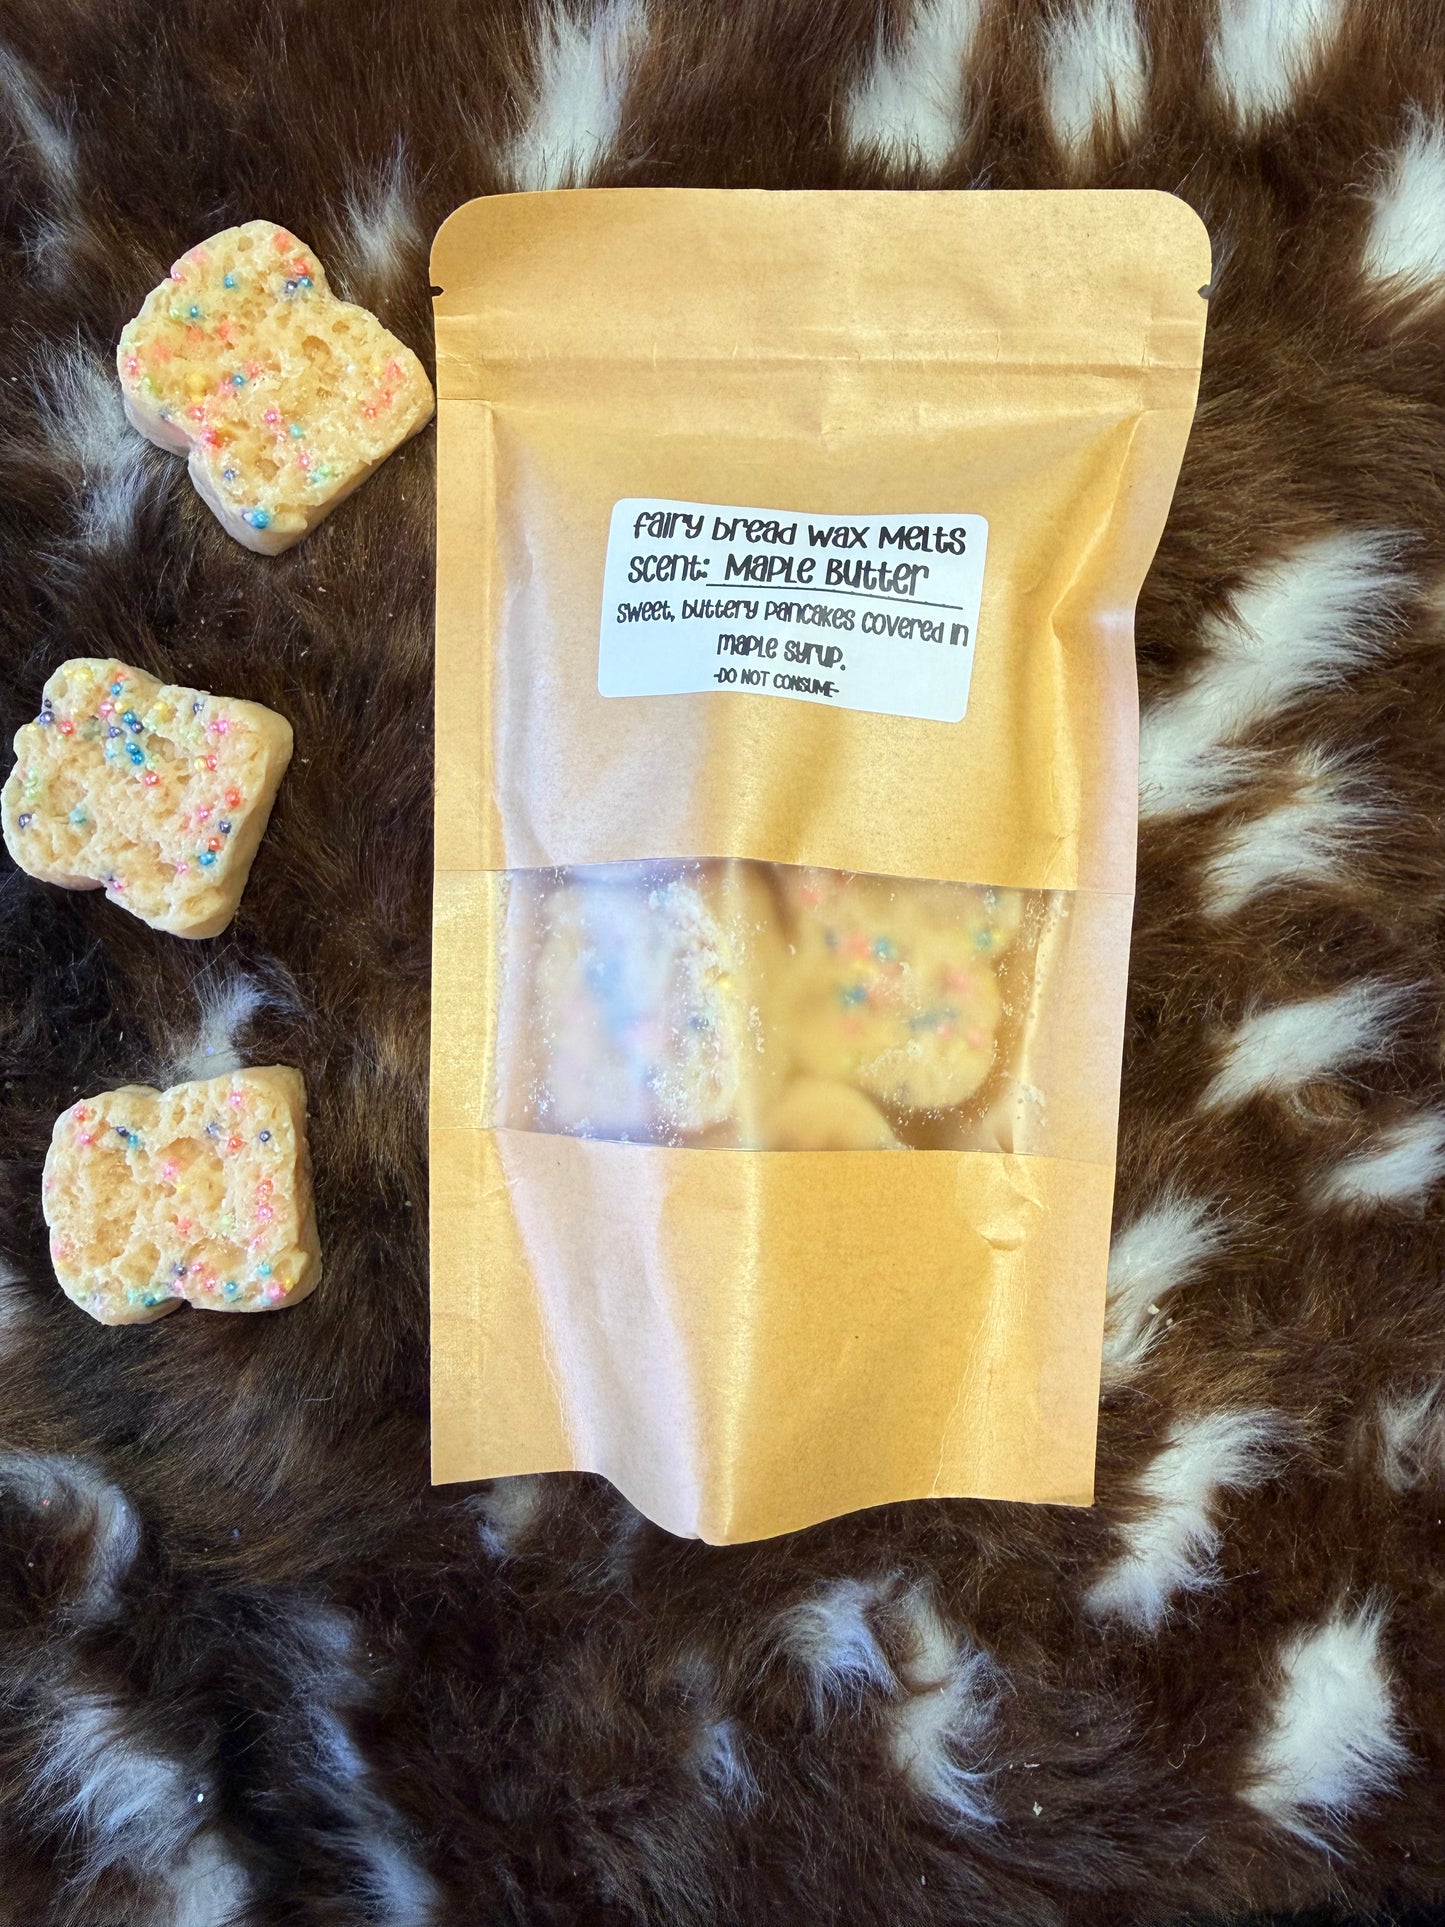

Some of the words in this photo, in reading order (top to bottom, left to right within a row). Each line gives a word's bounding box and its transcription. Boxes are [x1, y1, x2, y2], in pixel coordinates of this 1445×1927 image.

[711, 516, 798, 546] bread
[824, 558, 930, 597] Butter
[681, 599, 760, 621] buttery
[716, 633, 779, 660] maple
[783, 640, 847, 672] syrup.
[740, 668, 771, 687] NOT
